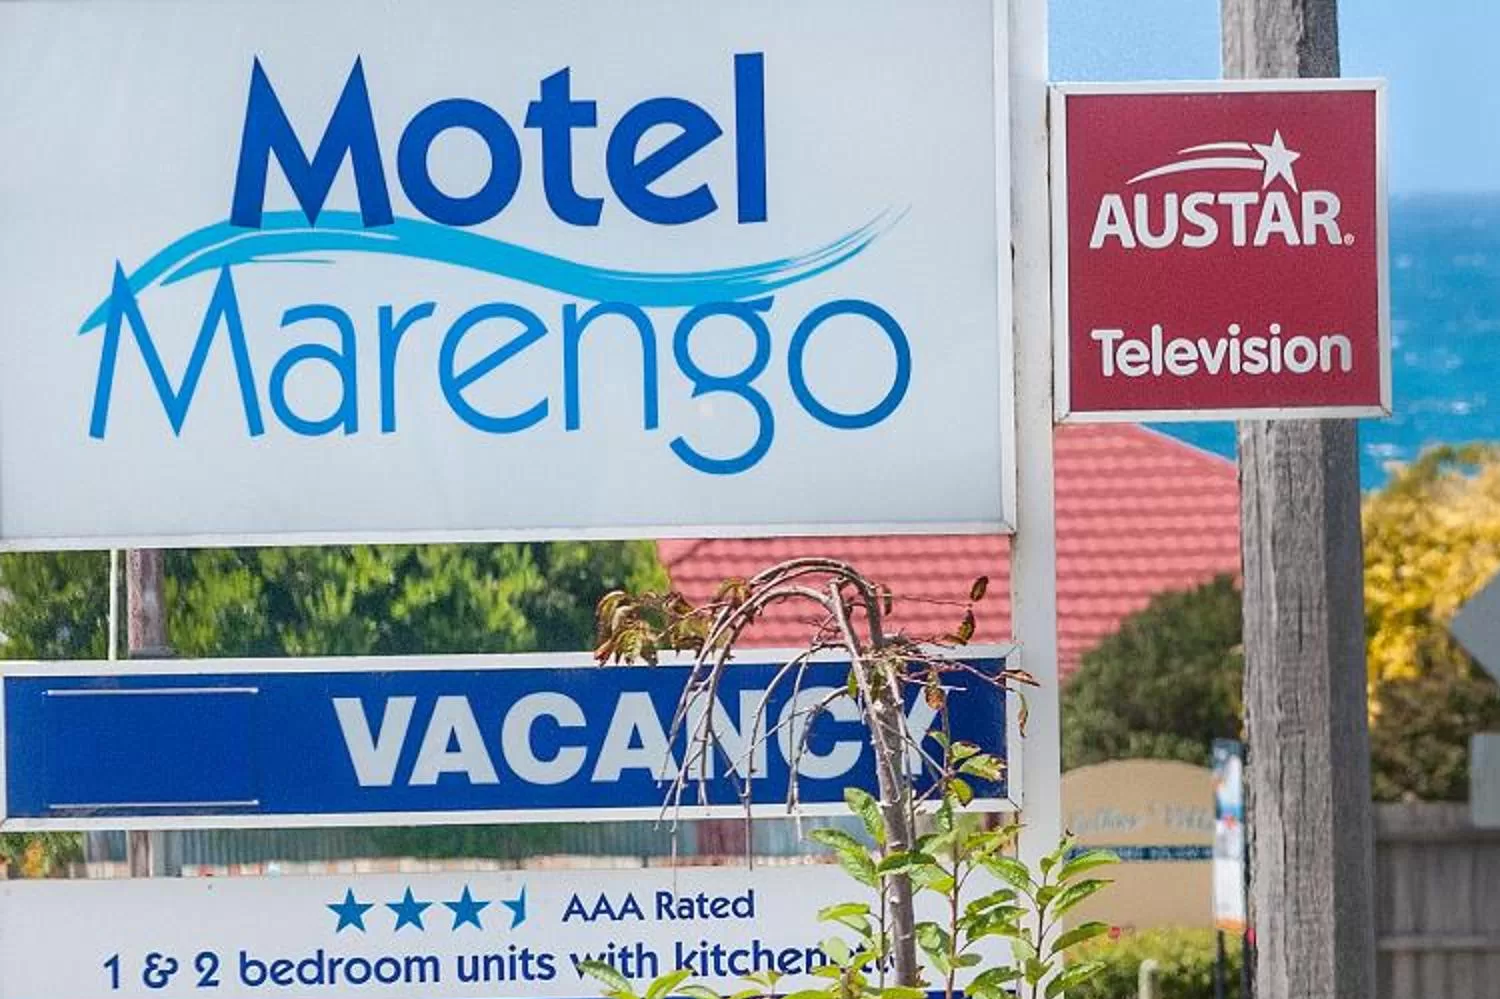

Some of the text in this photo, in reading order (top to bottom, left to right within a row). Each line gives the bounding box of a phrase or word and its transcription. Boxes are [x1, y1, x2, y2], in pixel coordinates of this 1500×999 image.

[230, 52, 767, 227] Motel
[88, 259, 912, 476] Marengo
[1090, 323, 1353, 377] Television
[562, 888, 755, 923] AAA Rated
[103, 953, 120, 990] 1
[142, 952, 179, 989] &
[194, 951, 220, 988] 2
[239, 947, 441, 987] bedroom
[457, 943, 557, 983] units
[569, 941, 659, 981] with
